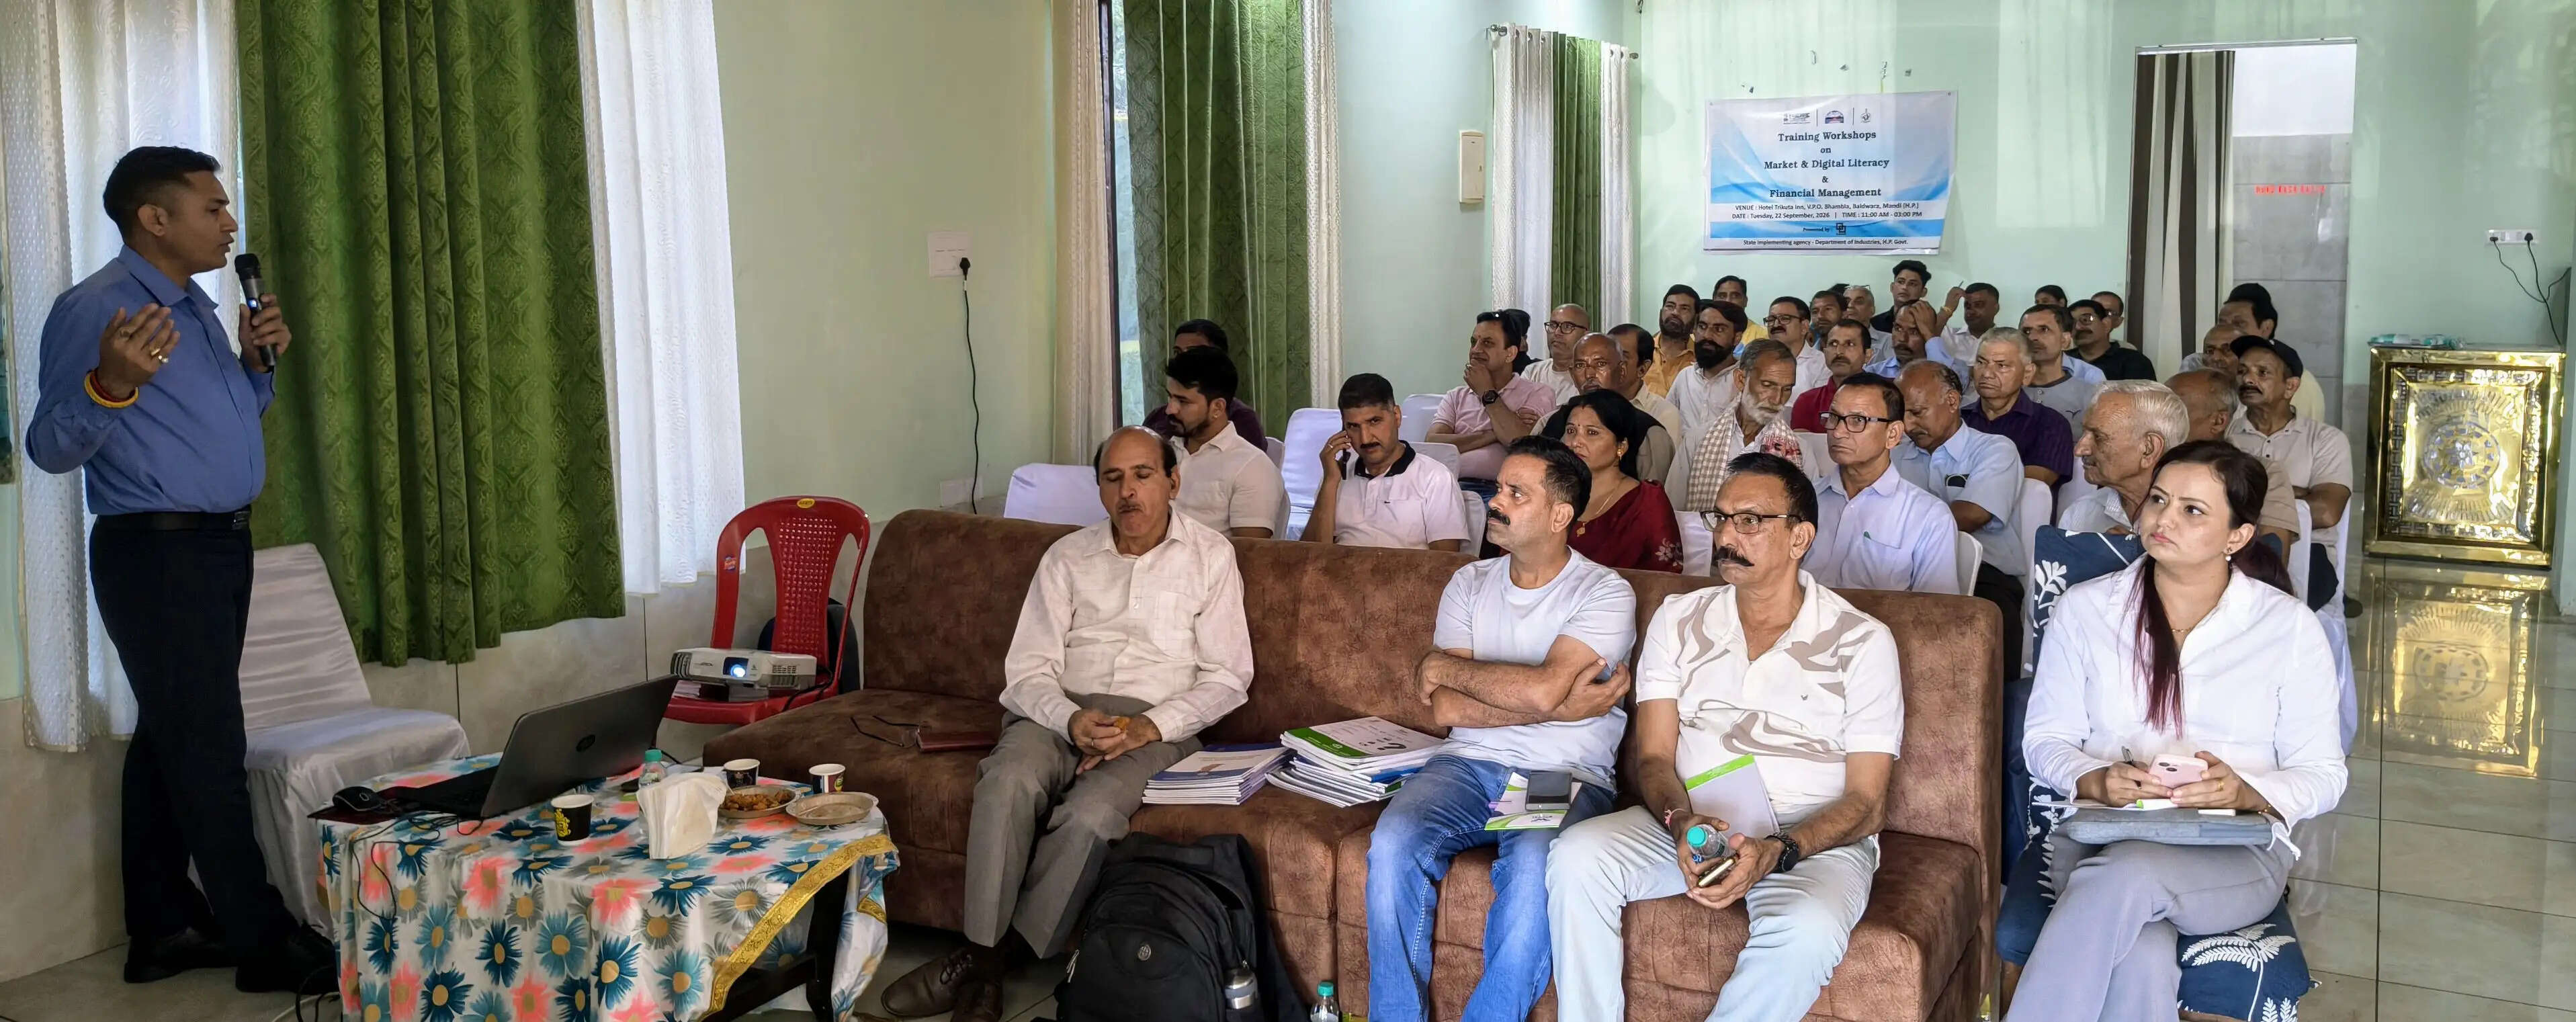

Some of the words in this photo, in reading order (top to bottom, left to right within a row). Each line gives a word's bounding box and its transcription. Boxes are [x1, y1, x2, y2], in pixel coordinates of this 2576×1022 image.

[1778, 132, 1819, 142] Training
[1823, 131, 1877, 141] Workshops
[1764, 160, 1798, 169] Market
[1801, 160, 1809, 169] &
[1811, 159, 1845, 170] Digital
[1848, 159, 1889, 169] Literacy
[1821, 175, 1829, 183] &
[1770, 189, 1815, 198] Financial
[1817, 188, 1882, 199] Management
